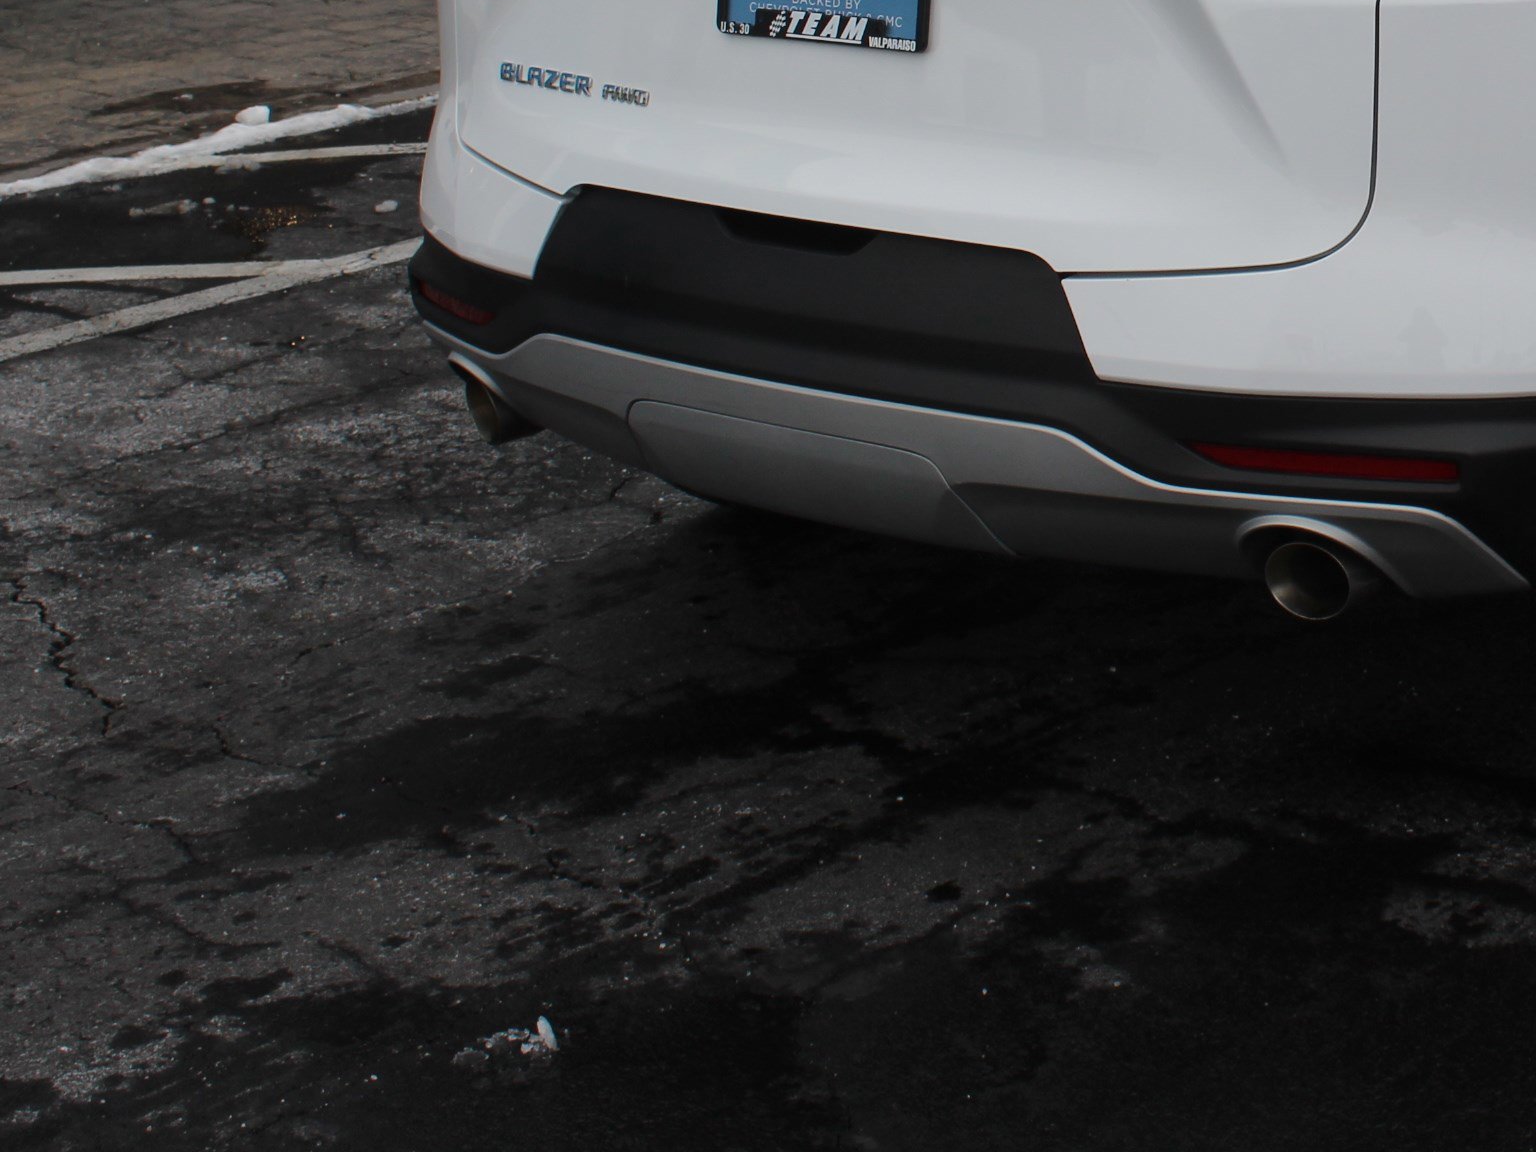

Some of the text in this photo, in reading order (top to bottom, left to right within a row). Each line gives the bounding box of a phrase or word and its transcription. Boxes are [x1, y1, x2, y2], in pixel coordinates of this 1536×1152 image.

[720, 20, 750, 36] U.S. 30
[787, 10, 869, 41] TEAM
[868, 36, 917, 52] VALPARAISO
[499, 61, 650, 107] BLAZER AWD
